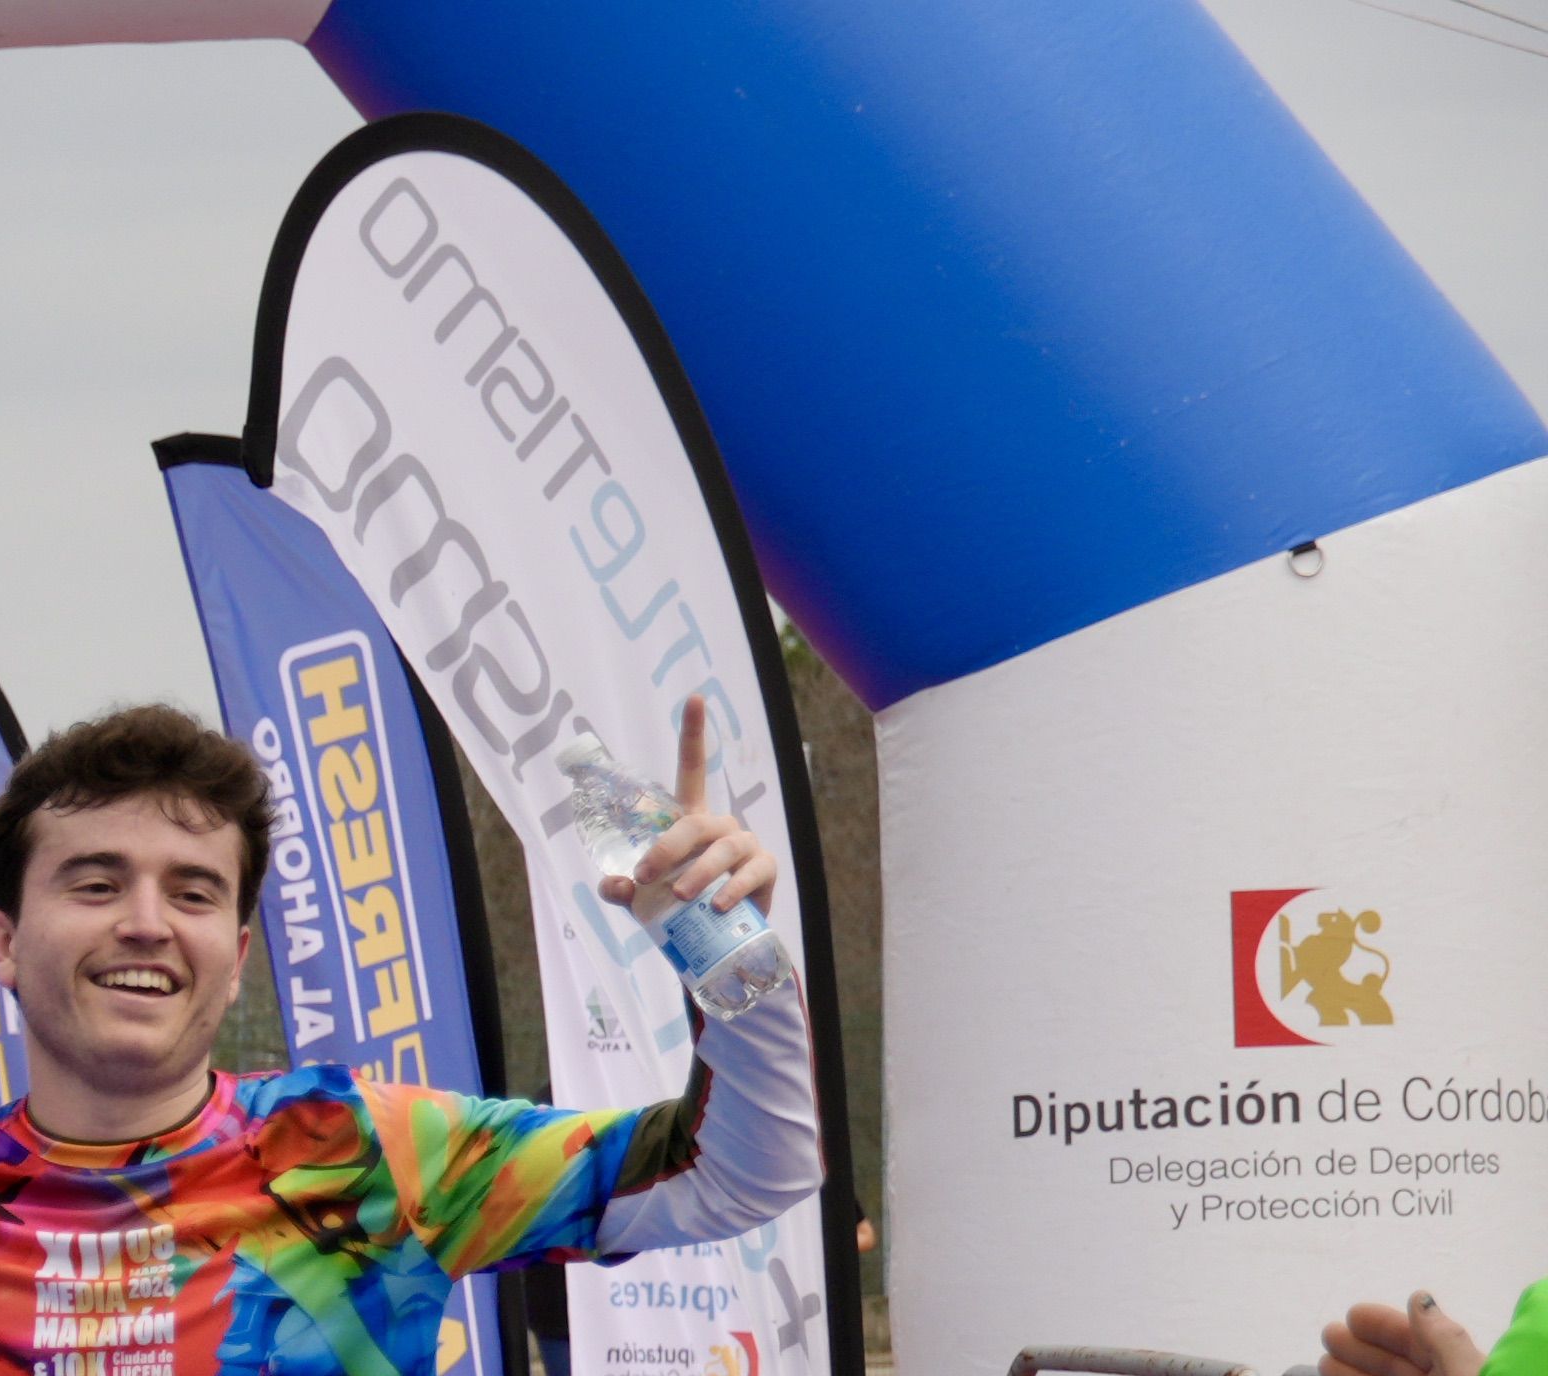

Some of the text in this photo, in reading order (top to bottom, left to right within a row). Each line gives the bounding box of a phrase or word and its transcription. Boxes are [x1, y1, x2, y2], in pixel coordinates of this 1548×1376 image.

[1012, 1075, 1548, 1146] Diputación de Córdob
[1109, 1146, 1500, 1187] Delegación de Deportes
[1170, 1188, 1453, 1230] y Protección Civil
[34, 1223, 176, 1280] XII 08
[35, 1281, 127, 1314] MEDIA
[128, 1277, 176, 1299] 2026
[33, 1306, 175, 1350] MARATÓN
[112, 1350, 155, 1366] Ciudad
[157, 1349, 174, 1364] de
